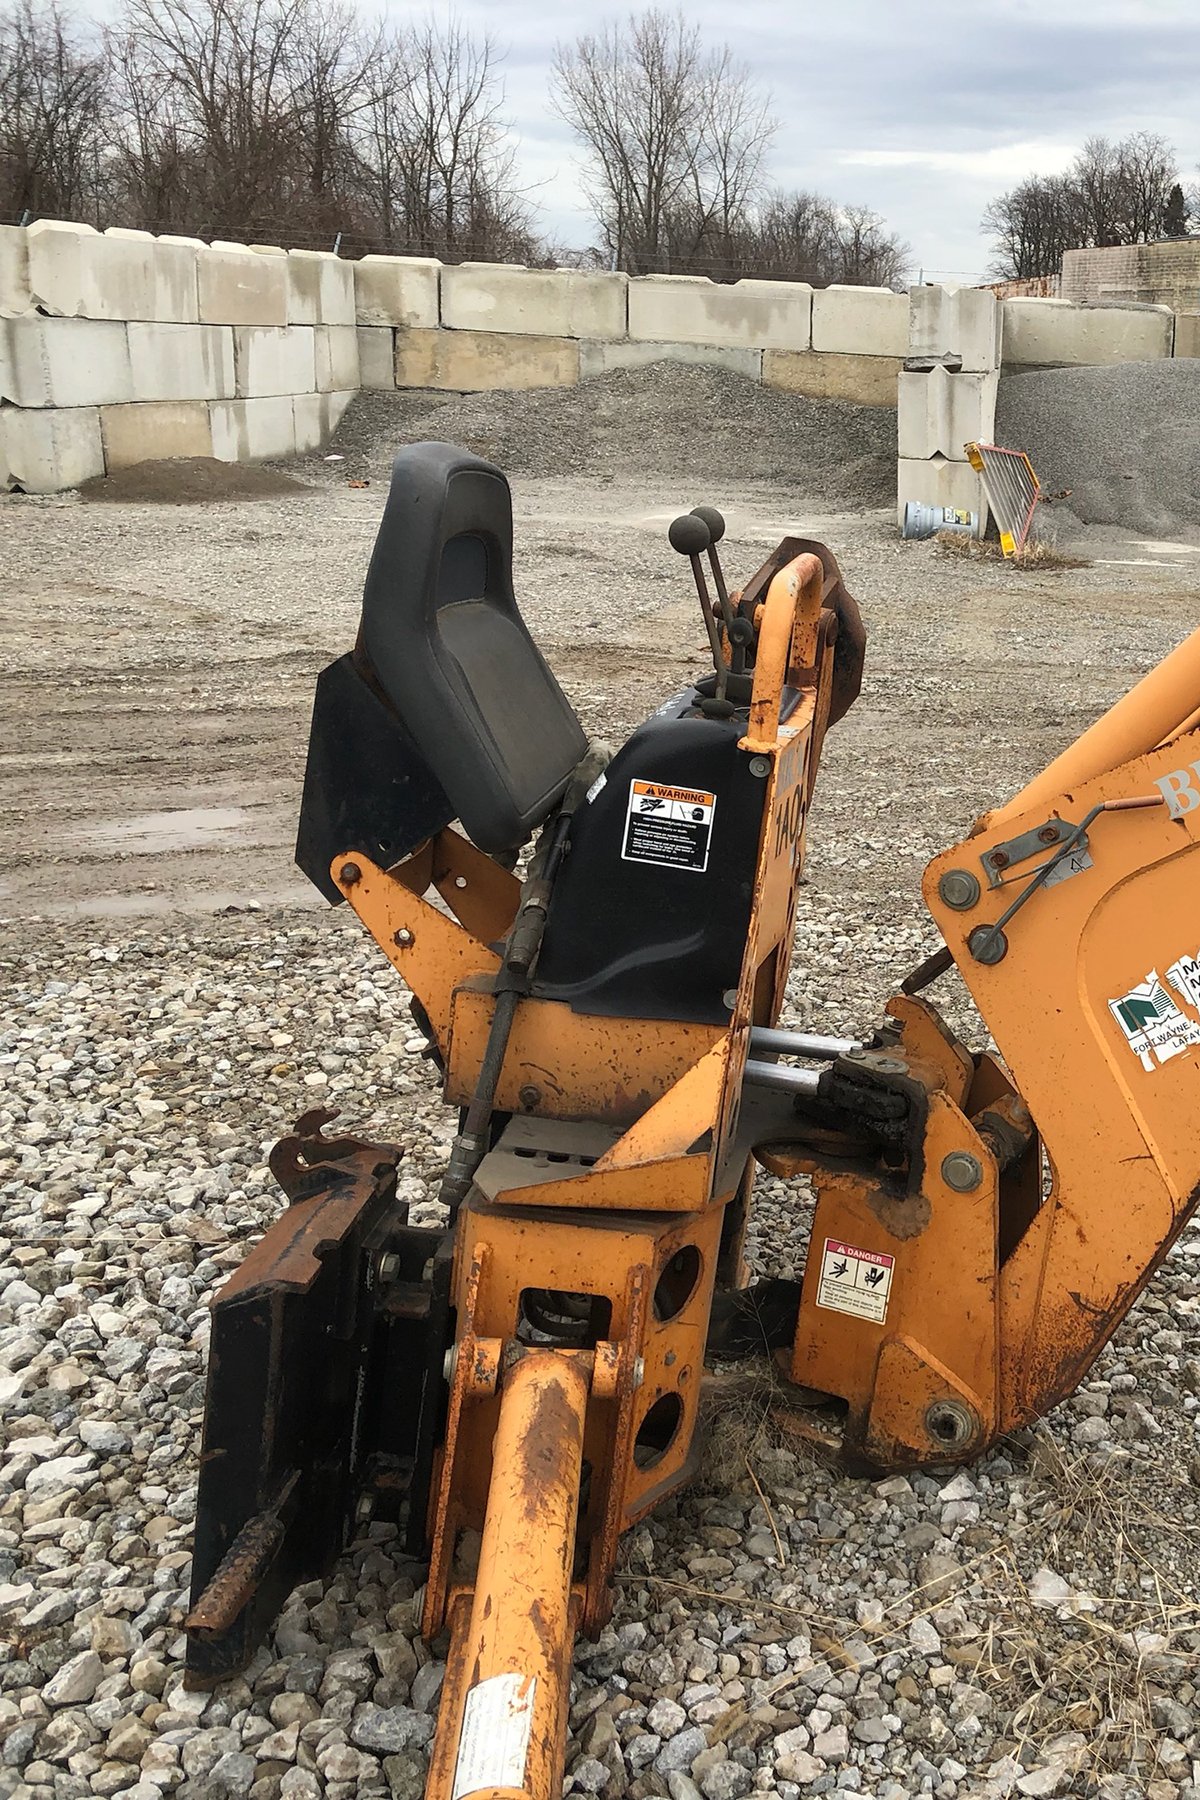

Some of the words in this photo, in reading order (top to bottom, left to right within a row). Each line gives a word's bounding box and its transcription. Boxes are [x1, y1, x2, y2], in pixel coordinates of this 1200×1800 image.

[657, 788, 705, 803] WARNING
[1157, 1021, 1190, 1042] WAYNE
[847, 1248, 883, 1263] DANGER
